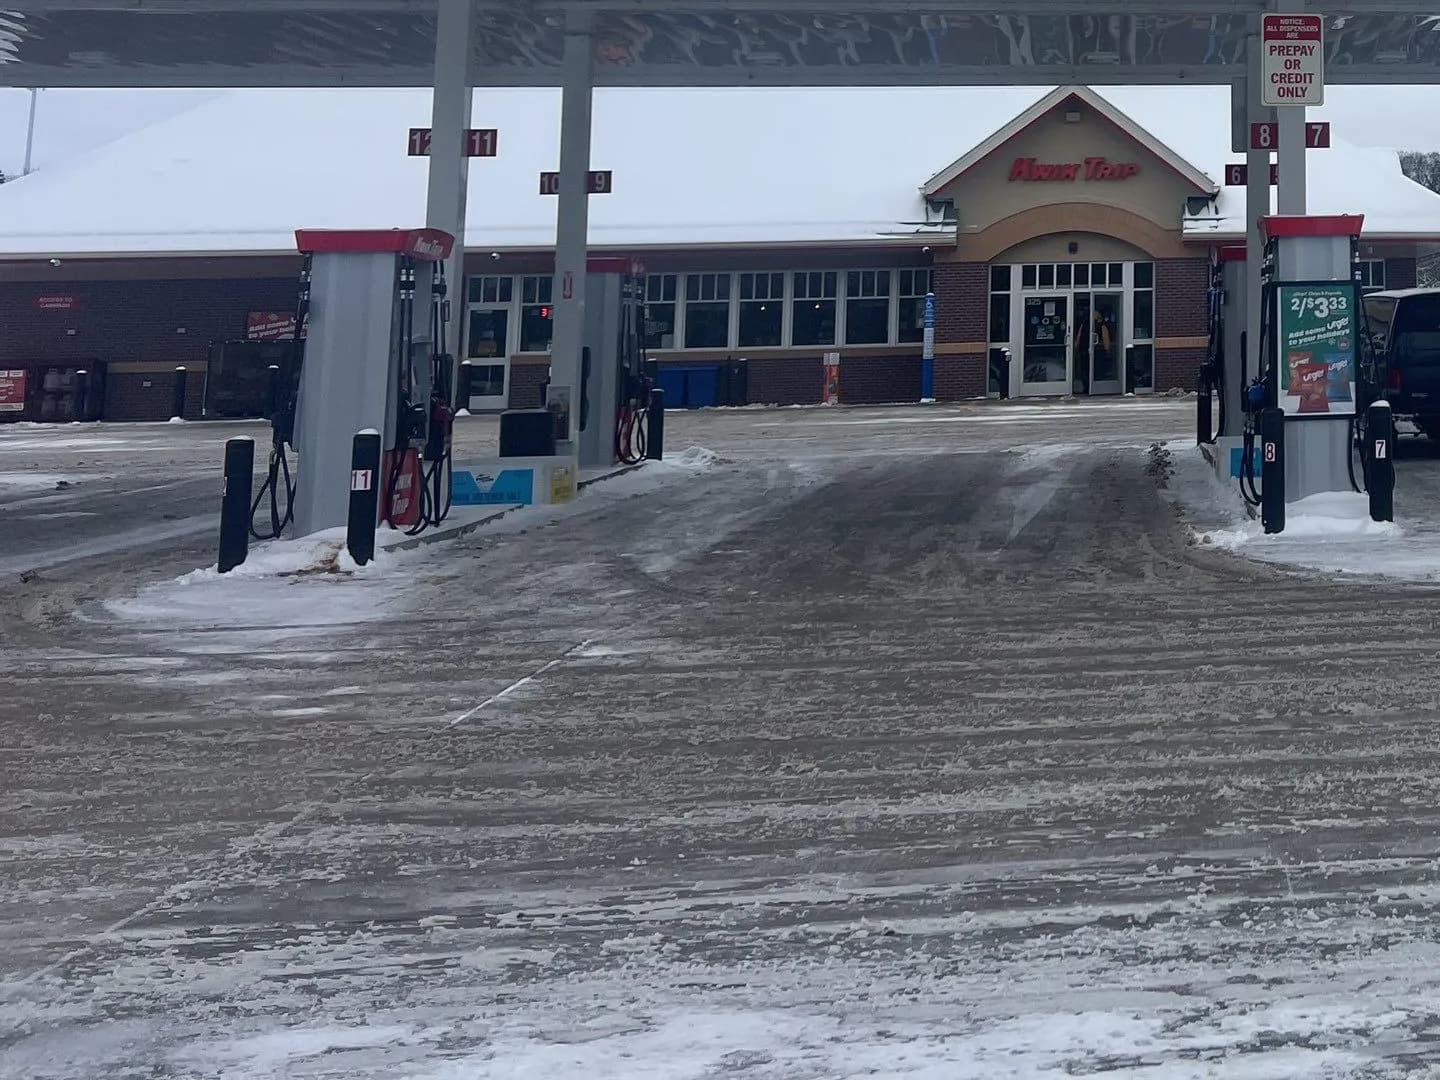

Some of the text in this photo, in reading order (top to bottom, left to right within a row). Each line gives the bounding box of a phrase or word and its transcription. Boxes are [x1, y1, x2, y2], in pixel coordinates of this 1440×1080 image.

[1269, 45, 1316, 57] PREPAY
[1284, 59, 1302, 70] OR
[1271, 73, 1315, 84] CREDIT
[1277, 87, 1308, 98] ONLY
[471, 131, 492, 155] 11
[1259, 124, 1271, 147] 8
[1312, 124, 1324, 147] 7
[595, 172, 605, 192] 9
[1231, 166, 1241, 185] 6
[1266, 443, 1274, 461] 8
[1376, 441, 1384, 457] 7
[351, 472, 369, 490] 11
